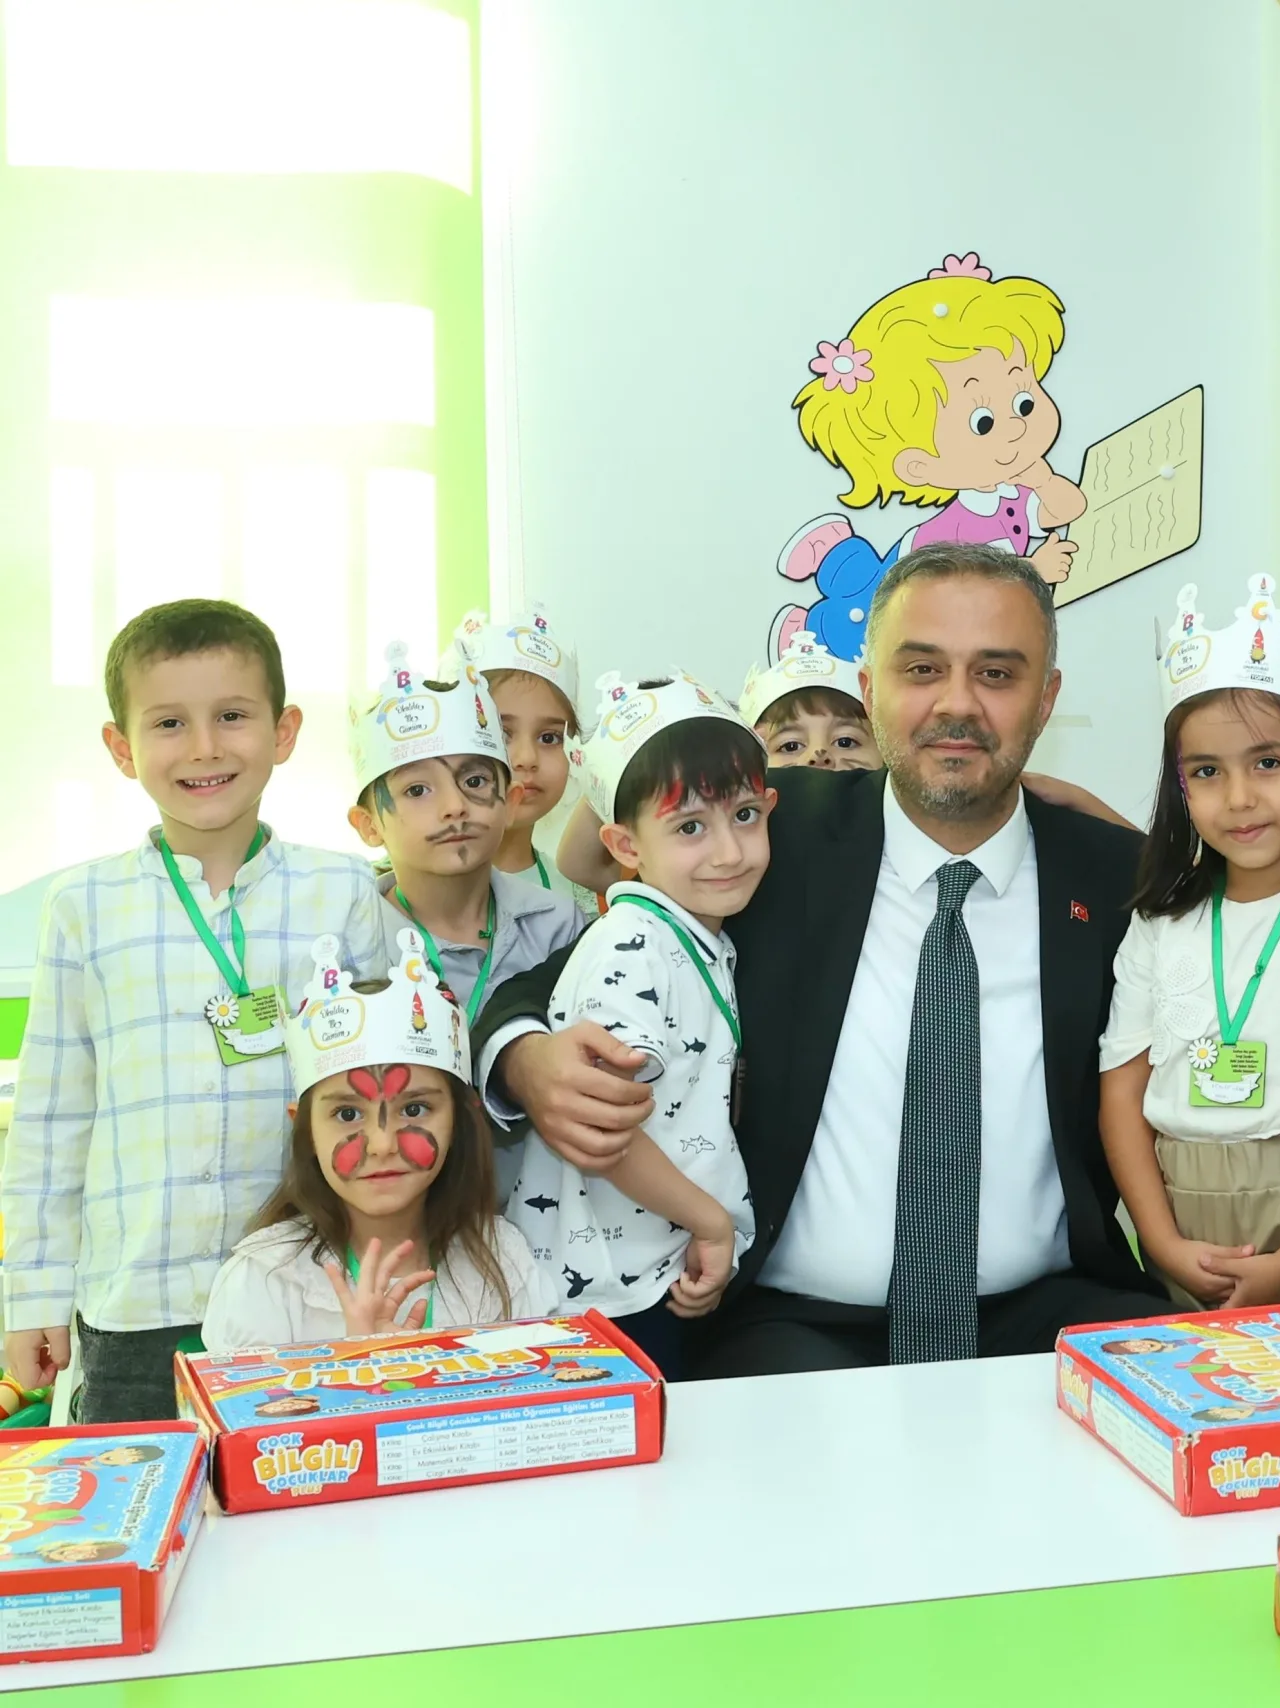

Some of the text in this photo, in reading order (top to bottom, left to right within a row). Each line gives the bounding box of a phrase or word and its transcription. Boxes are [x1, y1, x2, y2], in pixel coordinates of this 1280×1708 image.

[324, 969, 338, 989] B
[308, 1346, 479, 1371] OCUKLAR
[258, 1433, 302, 1454] ÇOOK
[256, 1441, 360, 1480] BİLGİLİ
[268, 1470, 348, 1492] ÇOCUKLAR
